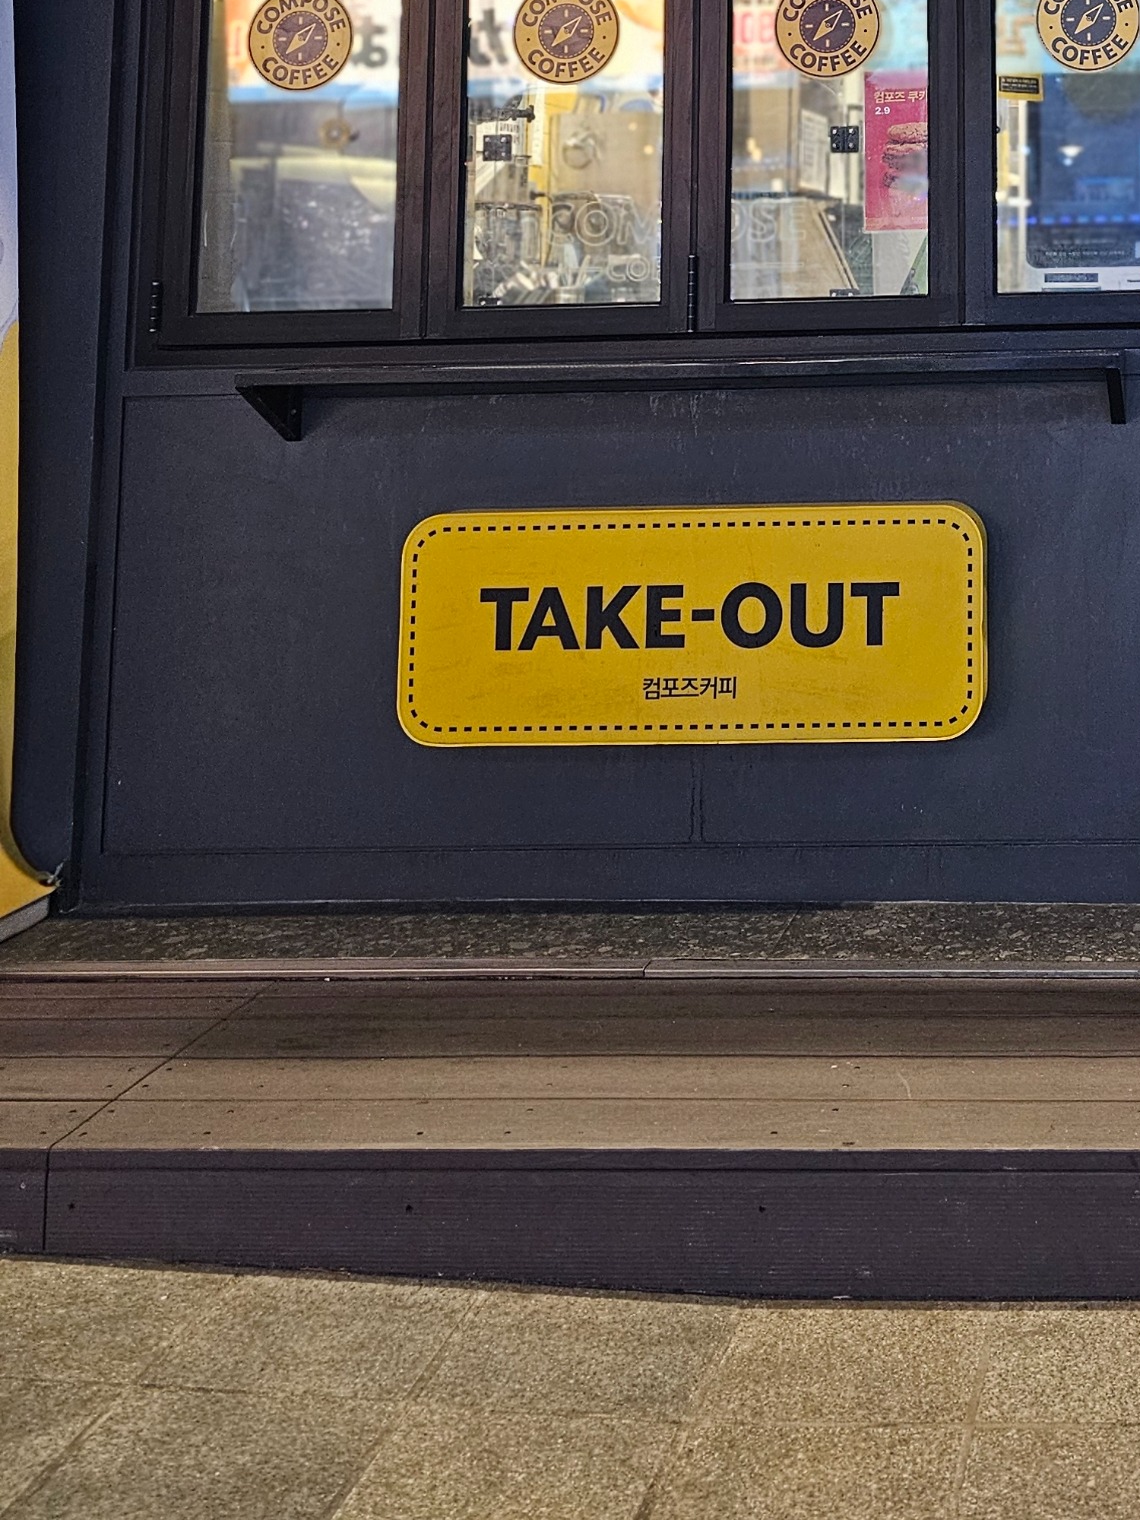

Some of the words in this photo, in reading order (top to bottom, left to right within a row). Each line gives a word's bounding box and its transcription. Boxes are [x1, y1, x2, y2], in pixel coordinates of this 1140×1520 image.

[526, 45, 607, 79] COFFEE
[788, 39, 869, 73] COFFEE
[1050, 32, 1130, 66] COFFEE
[261, 53, 340, 86] COFFEE
[873, 90, 906, 103] 컴포즈
[874, 106, 891, 115] 2.9
[479, 581, 900, 652] TAKE-OUT
[641, 675, 738, 701] 컴포즈커피
